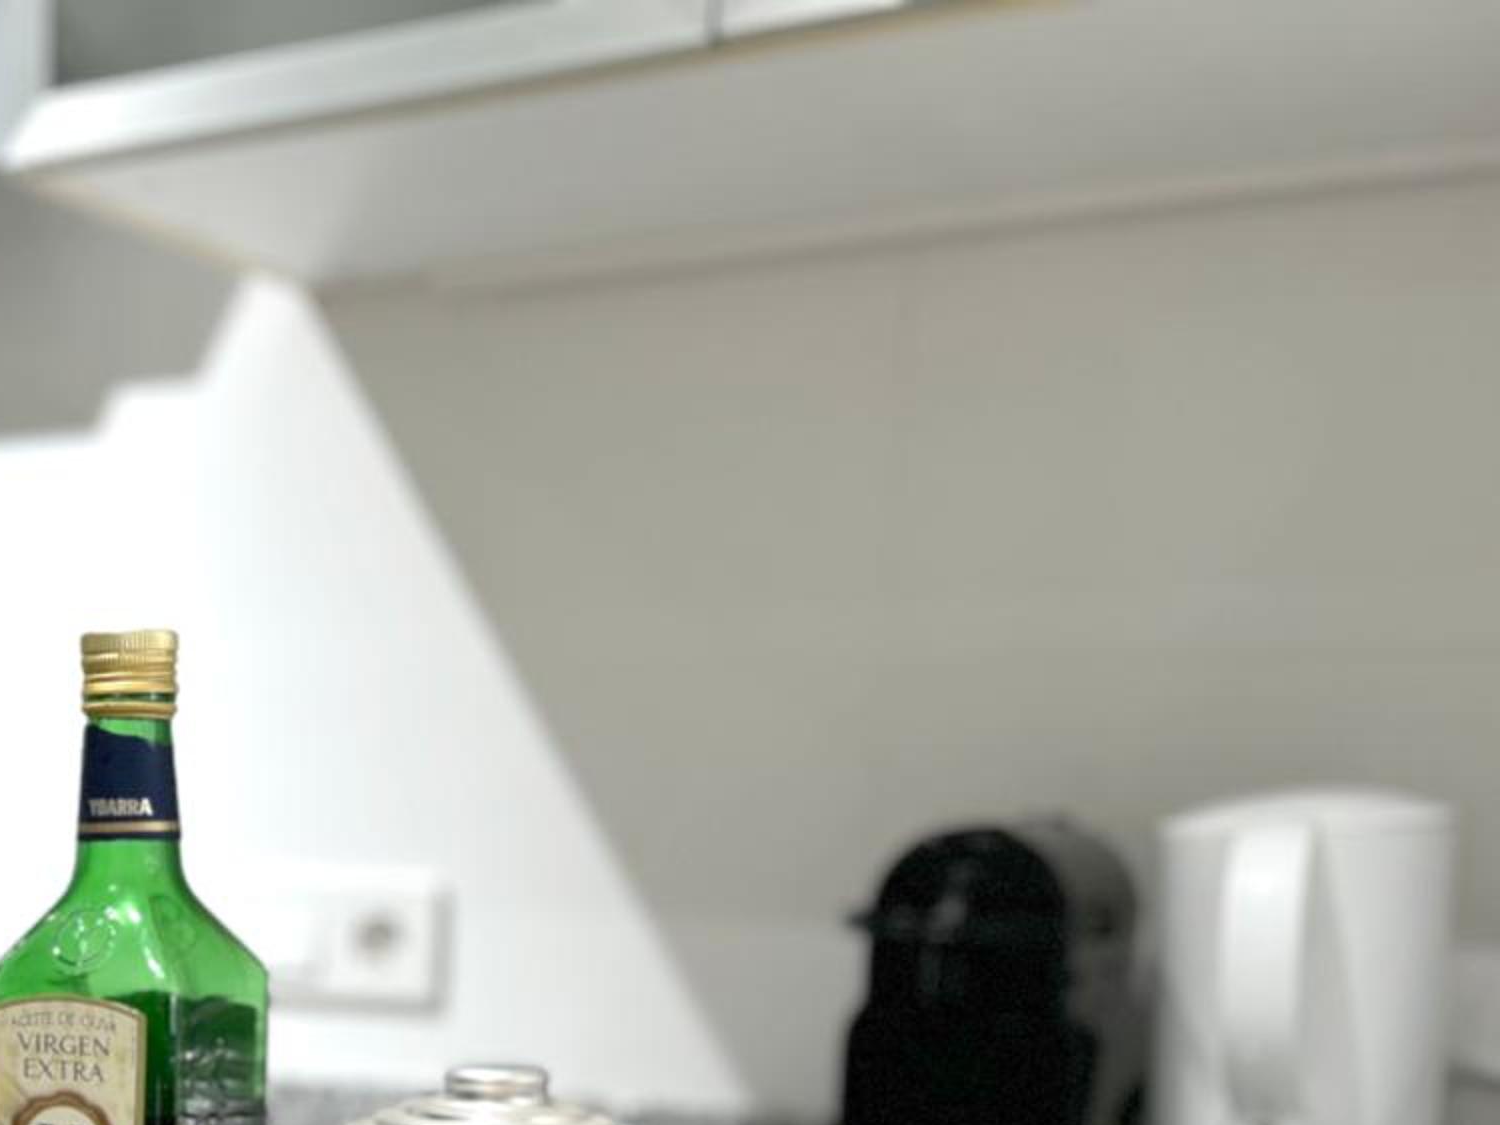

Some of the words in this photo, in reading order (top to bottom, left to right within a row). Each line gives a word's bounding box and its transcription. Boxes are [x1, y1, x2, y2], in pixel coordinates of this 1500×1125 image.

[88, 797, 154, 817] YBARRA
[17, 1031, 111, 1057] VIRGEN
[22, 1057, 105, 1083] EXTRA
